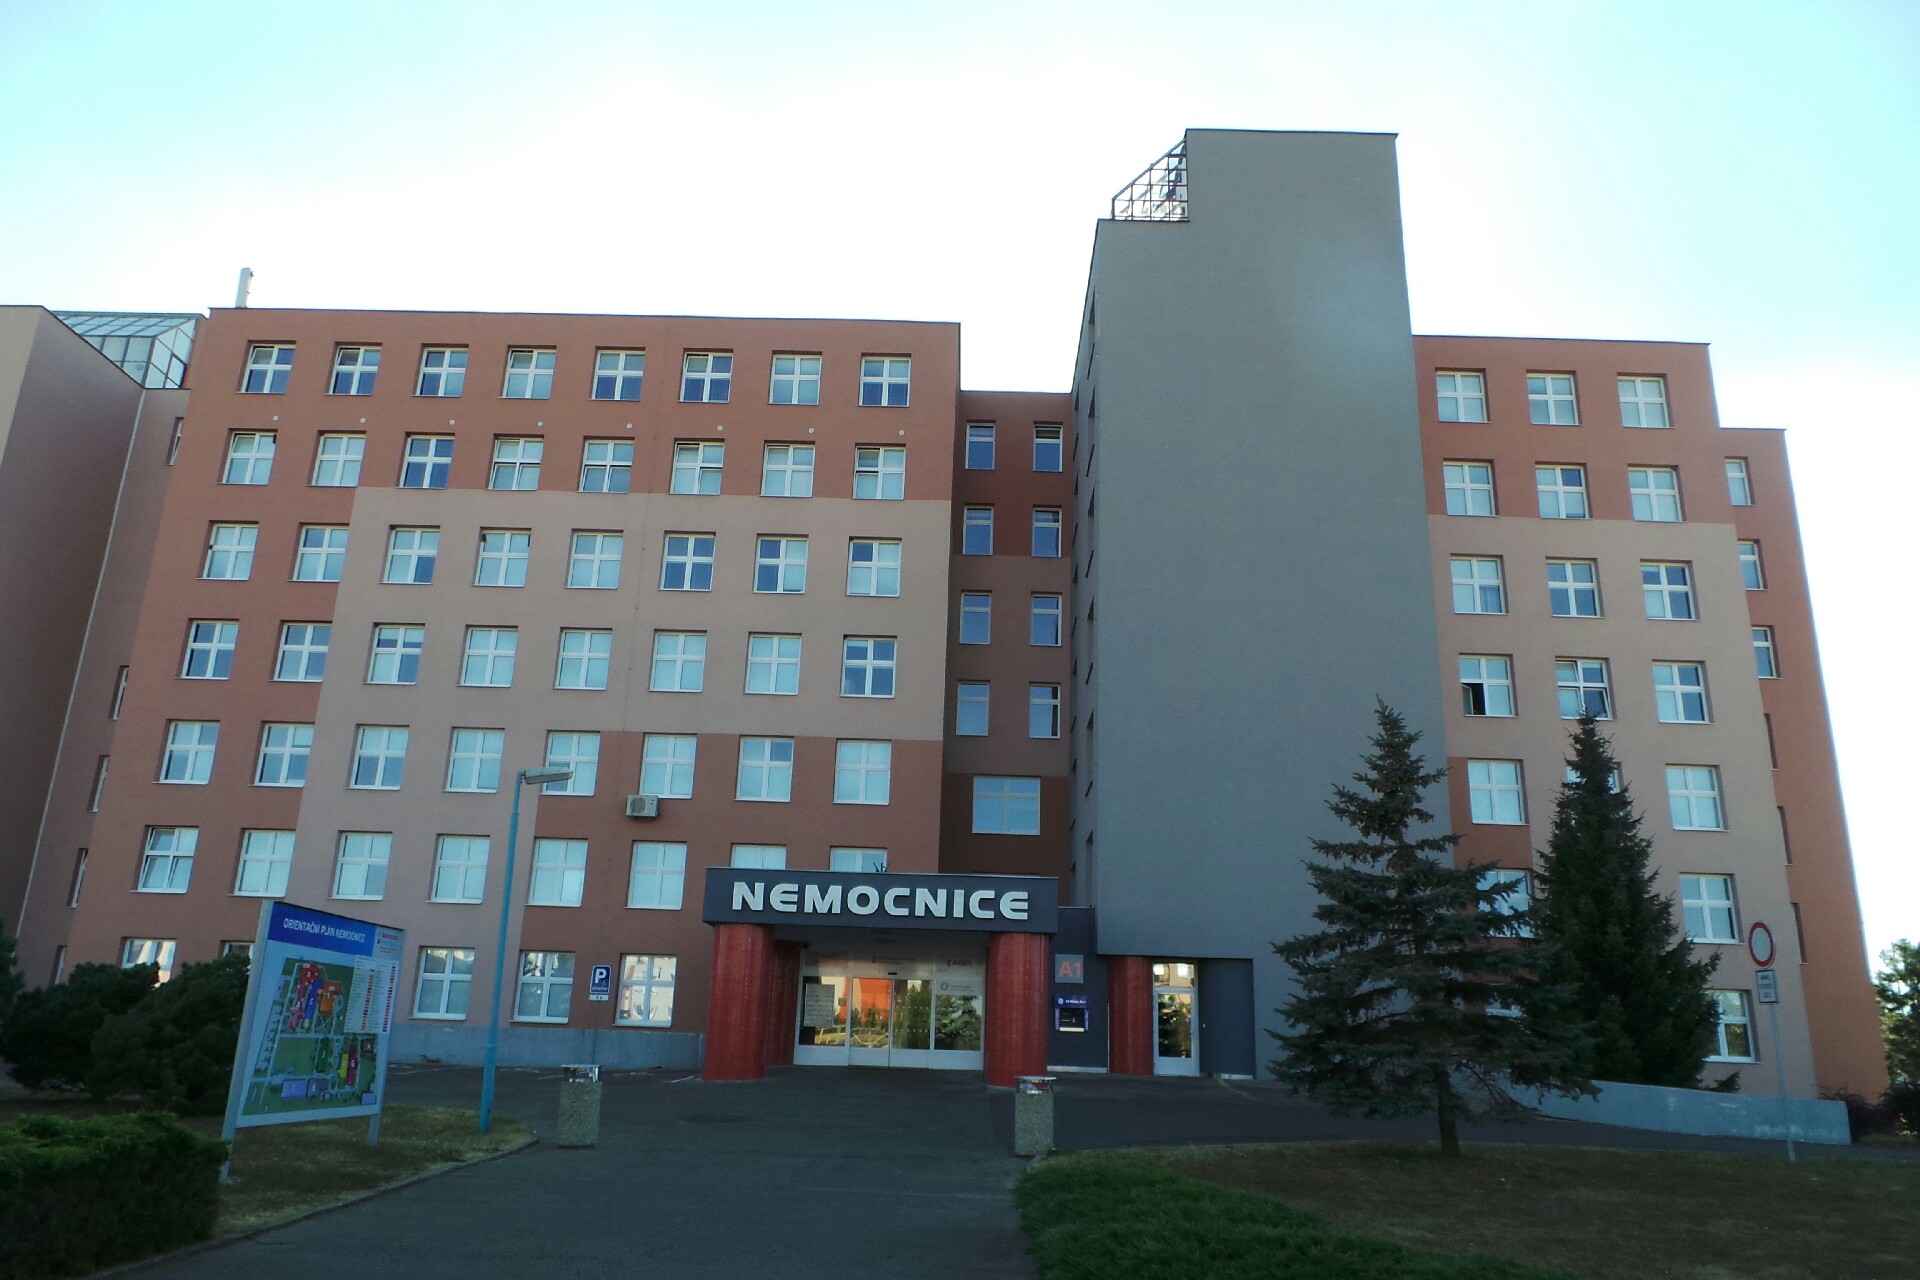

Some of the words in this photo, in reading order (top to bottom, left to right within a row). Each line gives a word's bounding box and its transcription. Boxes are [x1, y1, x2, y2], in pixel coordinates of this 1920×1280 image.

[732, 881, 1029, 920] NEMOCNICE
[283, 918, 321, 934] ORIENTAČNÍ
[321, 925, 335, 937] PLÁN
[335, 929, 366, 943] NEMOCNICE
[594, 968, 607, 984] P
[1058, 961, 1083, 977] A1
